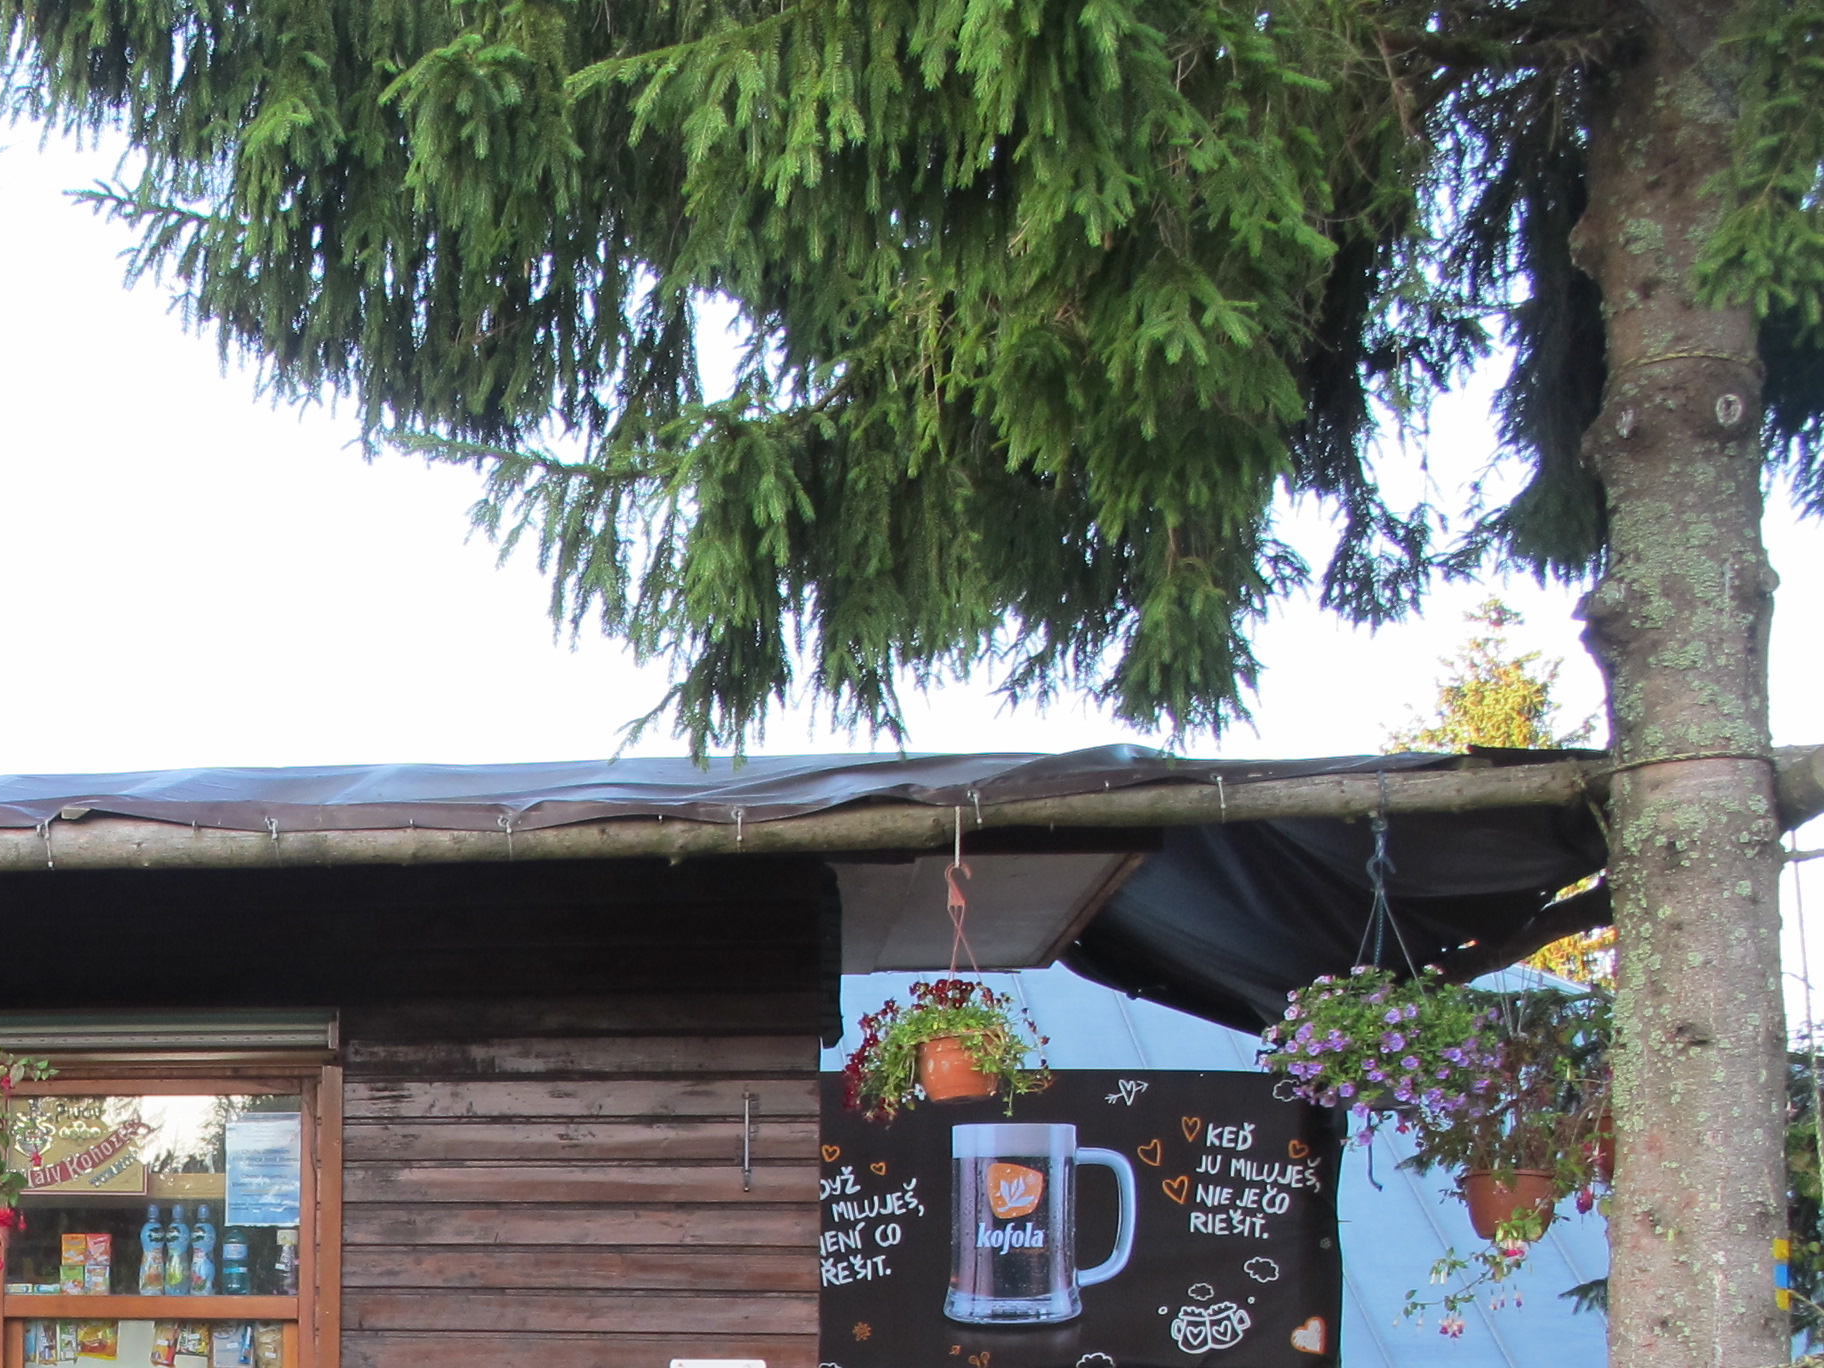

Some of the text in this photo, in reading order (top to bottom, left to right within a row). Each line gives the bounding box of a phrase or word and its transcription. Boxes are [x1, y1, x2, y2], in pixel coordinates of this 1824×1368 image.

[1205, 1121, 1256, 1151] KEĎ
[819, 1166, 861, 1201] DYŽ
[1195, 1154, 1322, 1193] JU MILUJEŠ,
[831, 1178, 925, 1222] MILUJEŠ,
[1196, 1183, 1290, 1214] NIE JE ČO
[874, 1223, 901, 1247] CO
[976, 1221, 1044, 1255] kofola
[1190, 1209, 1270, 1240] RIEŠIŤ.
[820, 1254, 892, 1287] ŘEŠIT.
